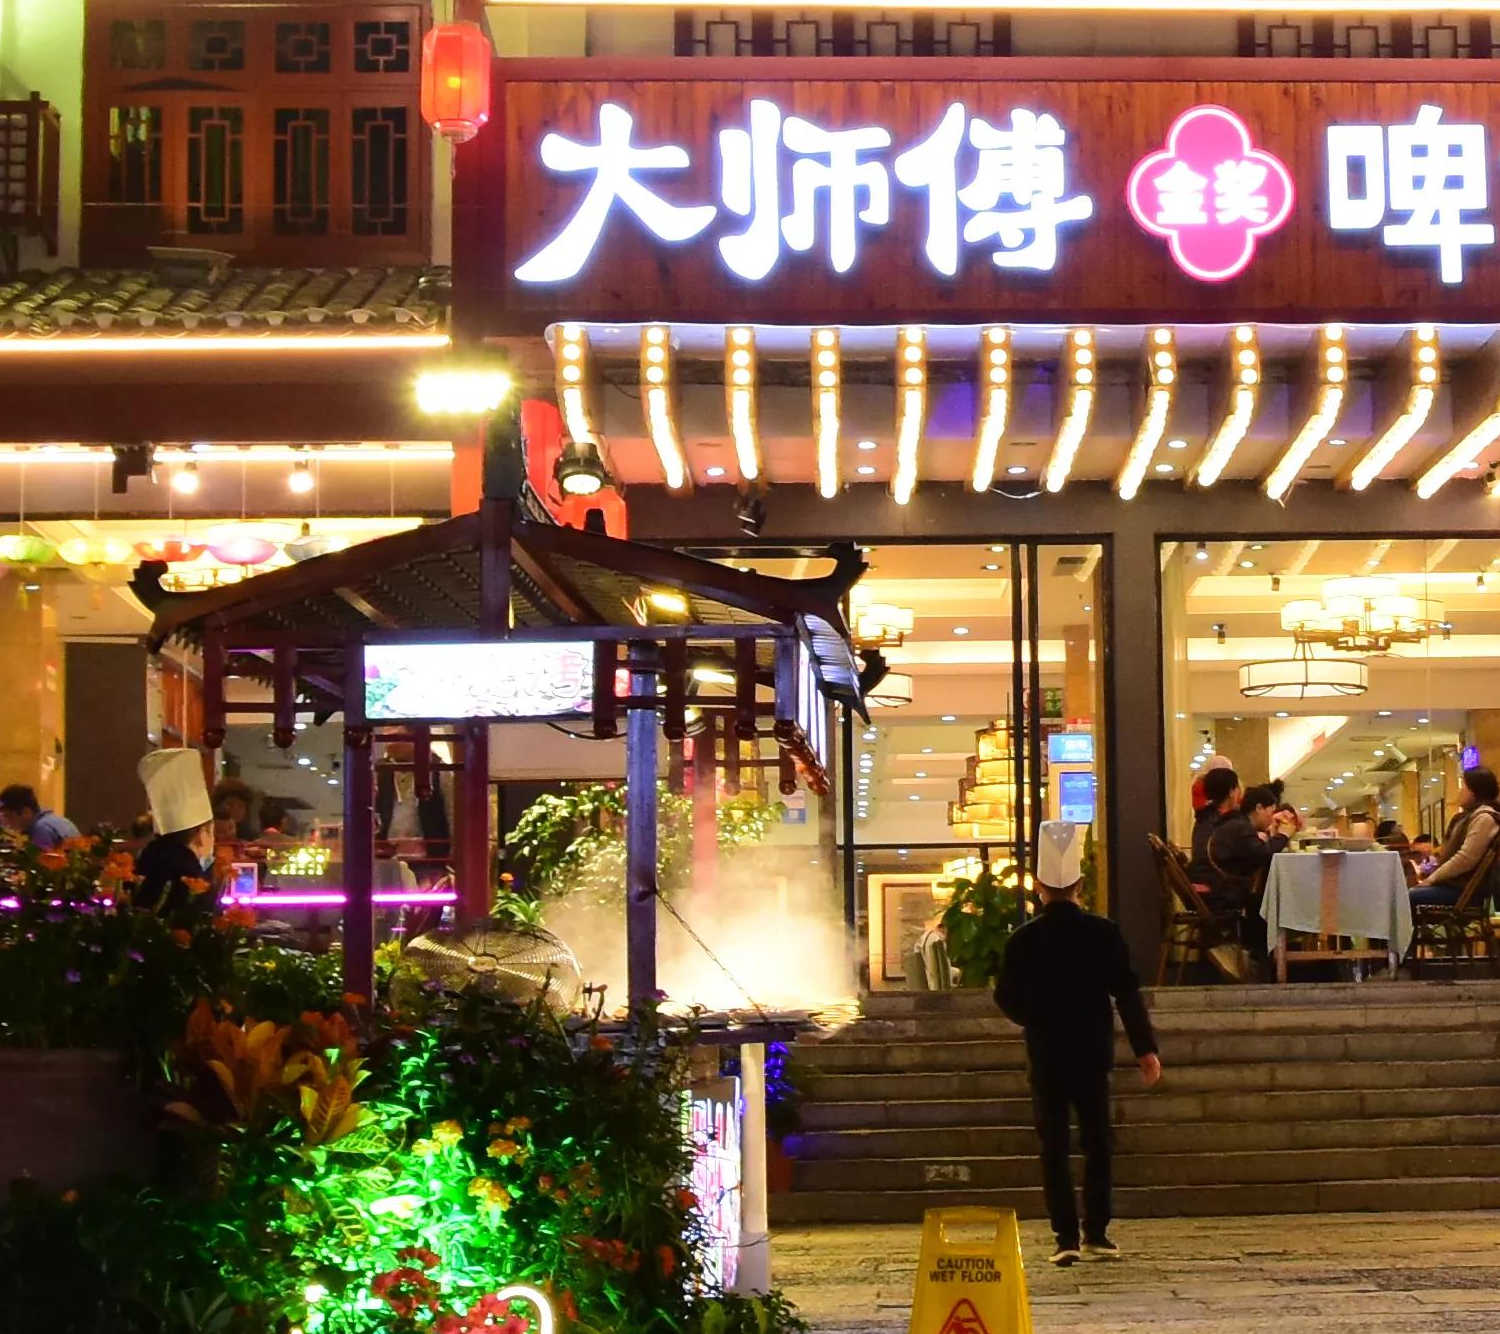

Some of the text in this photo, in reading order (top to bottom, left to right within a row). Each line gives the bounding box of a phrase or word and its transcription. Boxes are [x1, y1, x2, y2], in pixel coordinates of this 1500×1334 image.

[514, 99, 1092, 283] 大师傅
[1153, 159, 1269, 225] 金奖
[936, 1258, 995, 1270] CAUTION
[929, 1271, 1001, 1283] WET FLOOR
